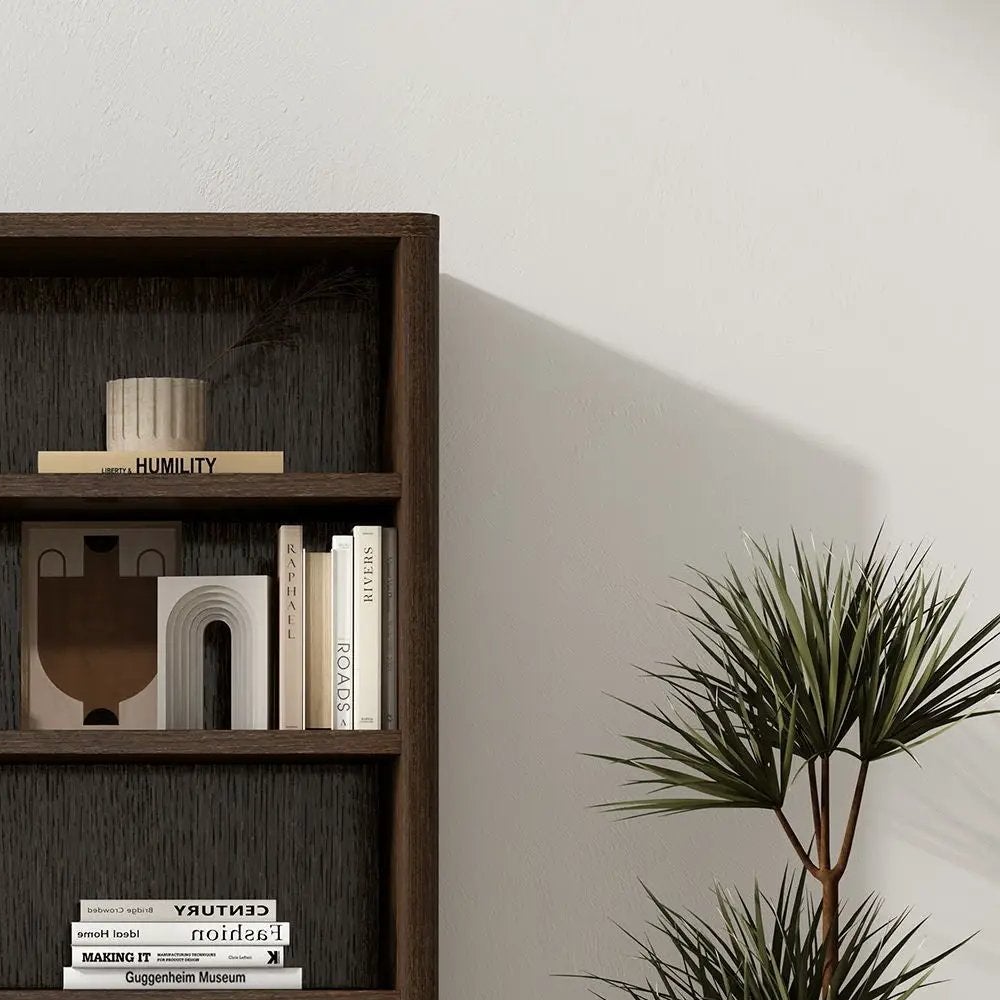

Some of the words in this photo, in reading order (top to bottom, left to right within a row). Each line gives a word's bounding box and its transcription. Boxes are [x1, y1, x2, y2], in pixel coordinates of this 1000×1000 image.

[136, 457, 217, 474] HUMILITY
[286, 543, 297, 640] RAPHAEL
[363, 546, 374, 603] RIVERS
[336, 642, 351, 712] ROADS
[82, 952, 134, 963] MAKING
[137, 952, 151, 963] IT
[125, 971, 196, 986] Guggenheim
[199, 971, 246, 983] Museum
